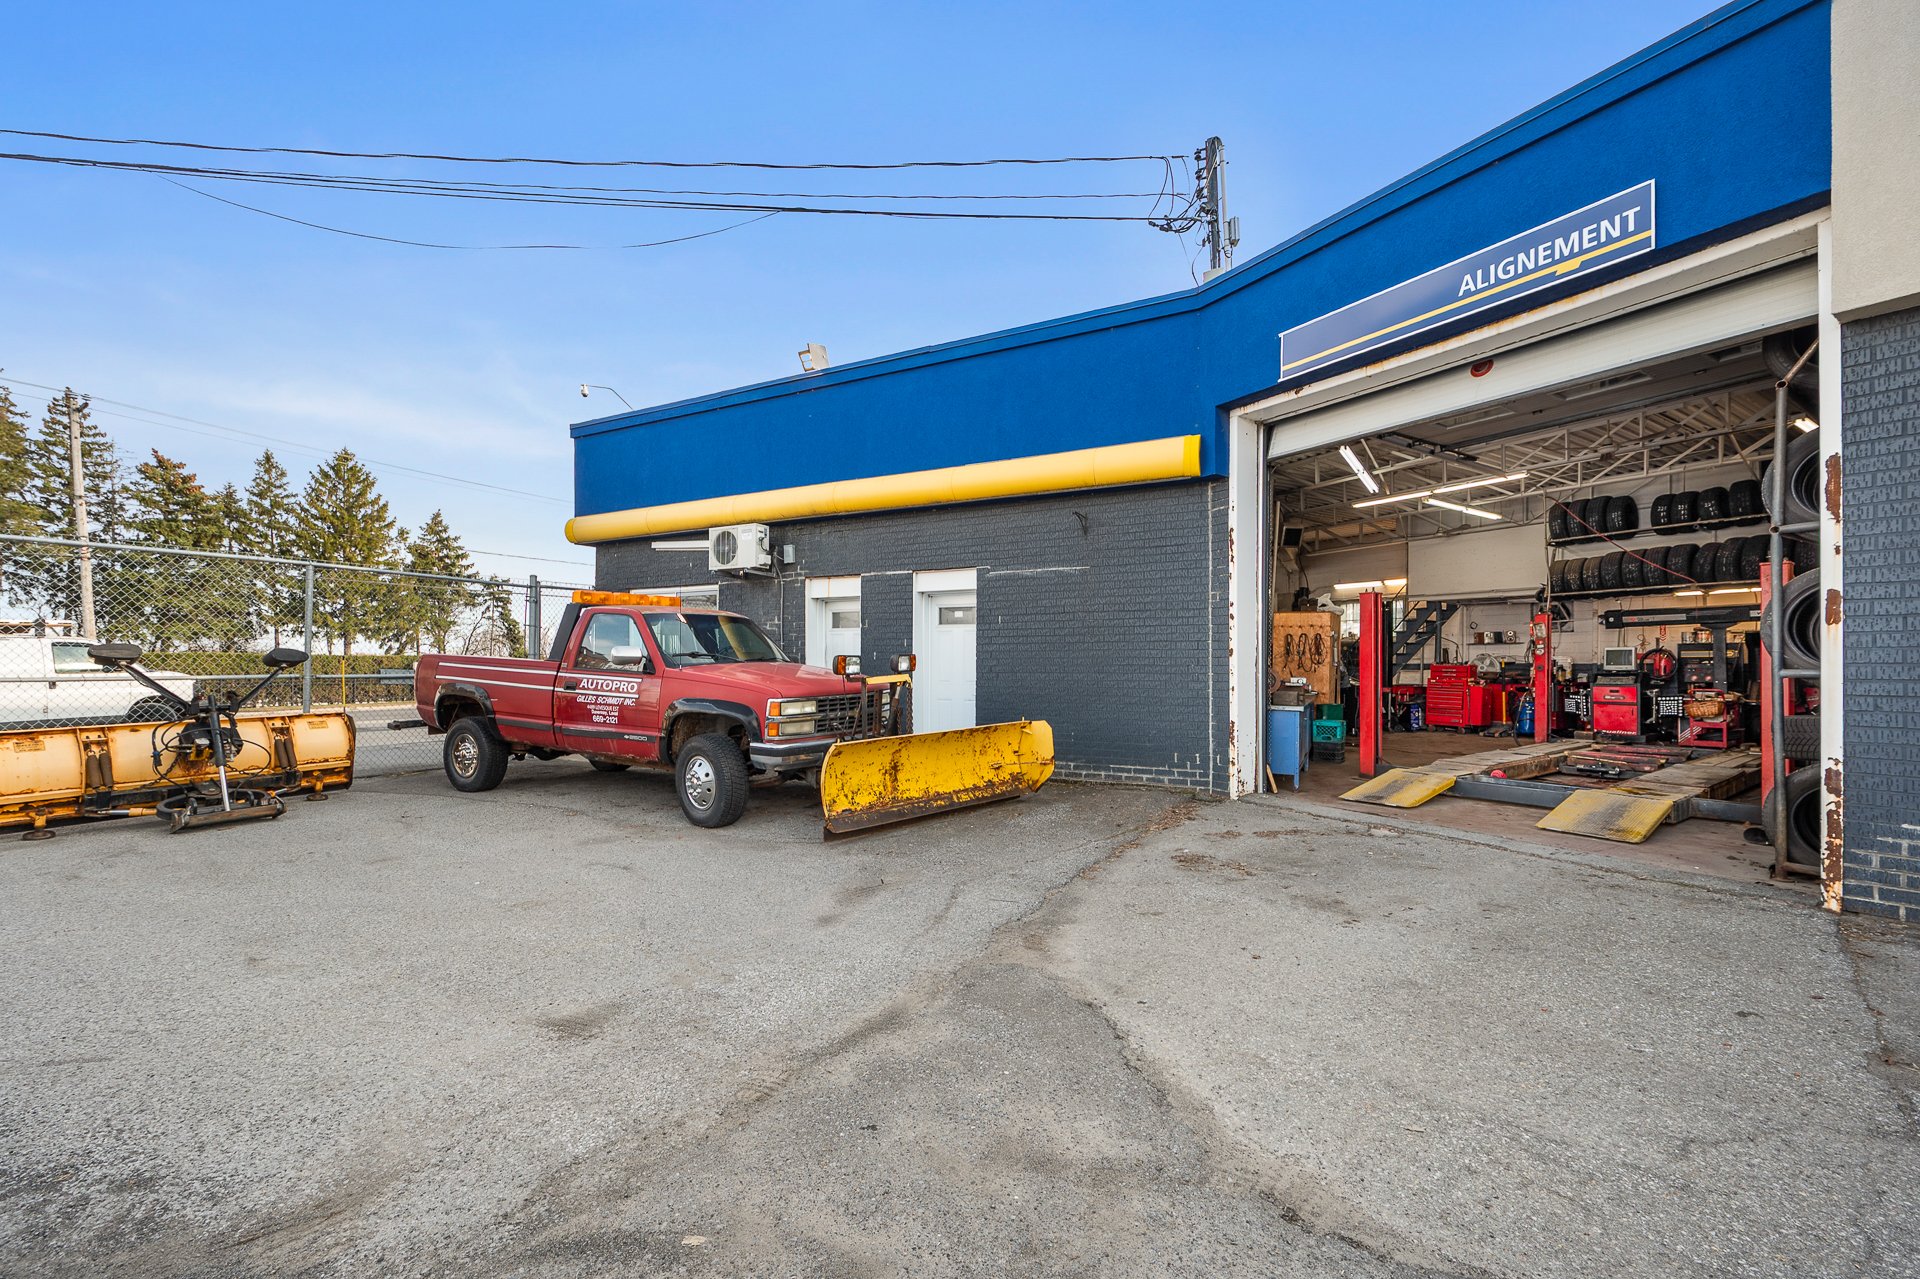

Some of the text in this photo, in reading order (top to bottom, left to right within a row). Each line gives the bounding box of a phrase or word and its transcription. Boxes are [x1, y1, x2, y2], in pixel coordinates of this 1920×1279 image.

[1458, 205, 1641, 297] ALIGNEMENT
[579, 679, 637, 692] AUTOPRO
[577, 695, 636, 706] GILLES SCHMIDT INC.
